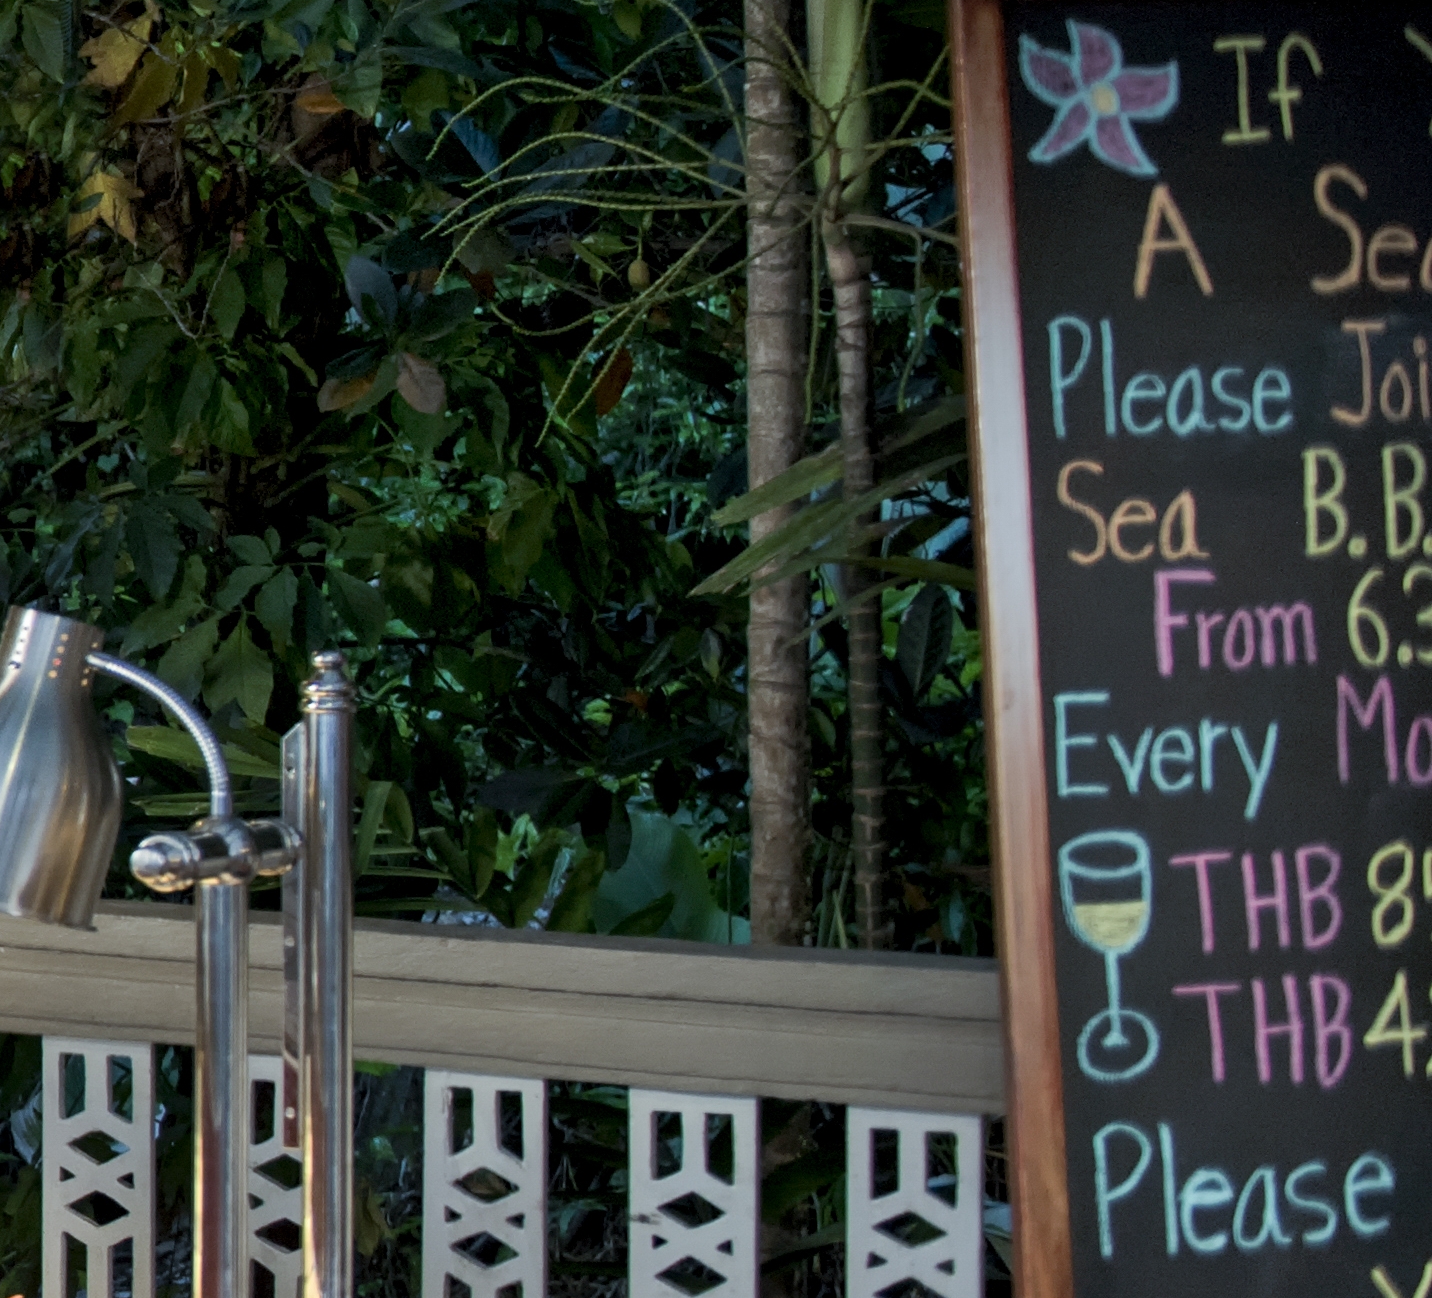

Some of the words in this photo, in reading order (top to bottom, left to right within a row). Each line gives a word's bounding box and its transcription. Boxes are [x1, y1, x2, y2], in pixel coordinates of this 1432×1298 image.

[1213, 32, 1324, 142] If
[1134, 184, 1213, 298] A
[1310, 163, 1432, 295] Se
[1047, 315, 1293, 438] Please
[1330, 320, 1432, 426] Joi
[1057, 460, 1210, 565] Sea
[1154, 568, 1318, 676] From
[1055, 691, 1279, 821] Every
[1170, 842, 1343, 953] THB
[1367, 839, 1432, 948] 8
[1172, 973, 1351, 1088] THB
[1362, 969, 1432, 1078] 4
[1092, 1121, 1395, 1259] Please
